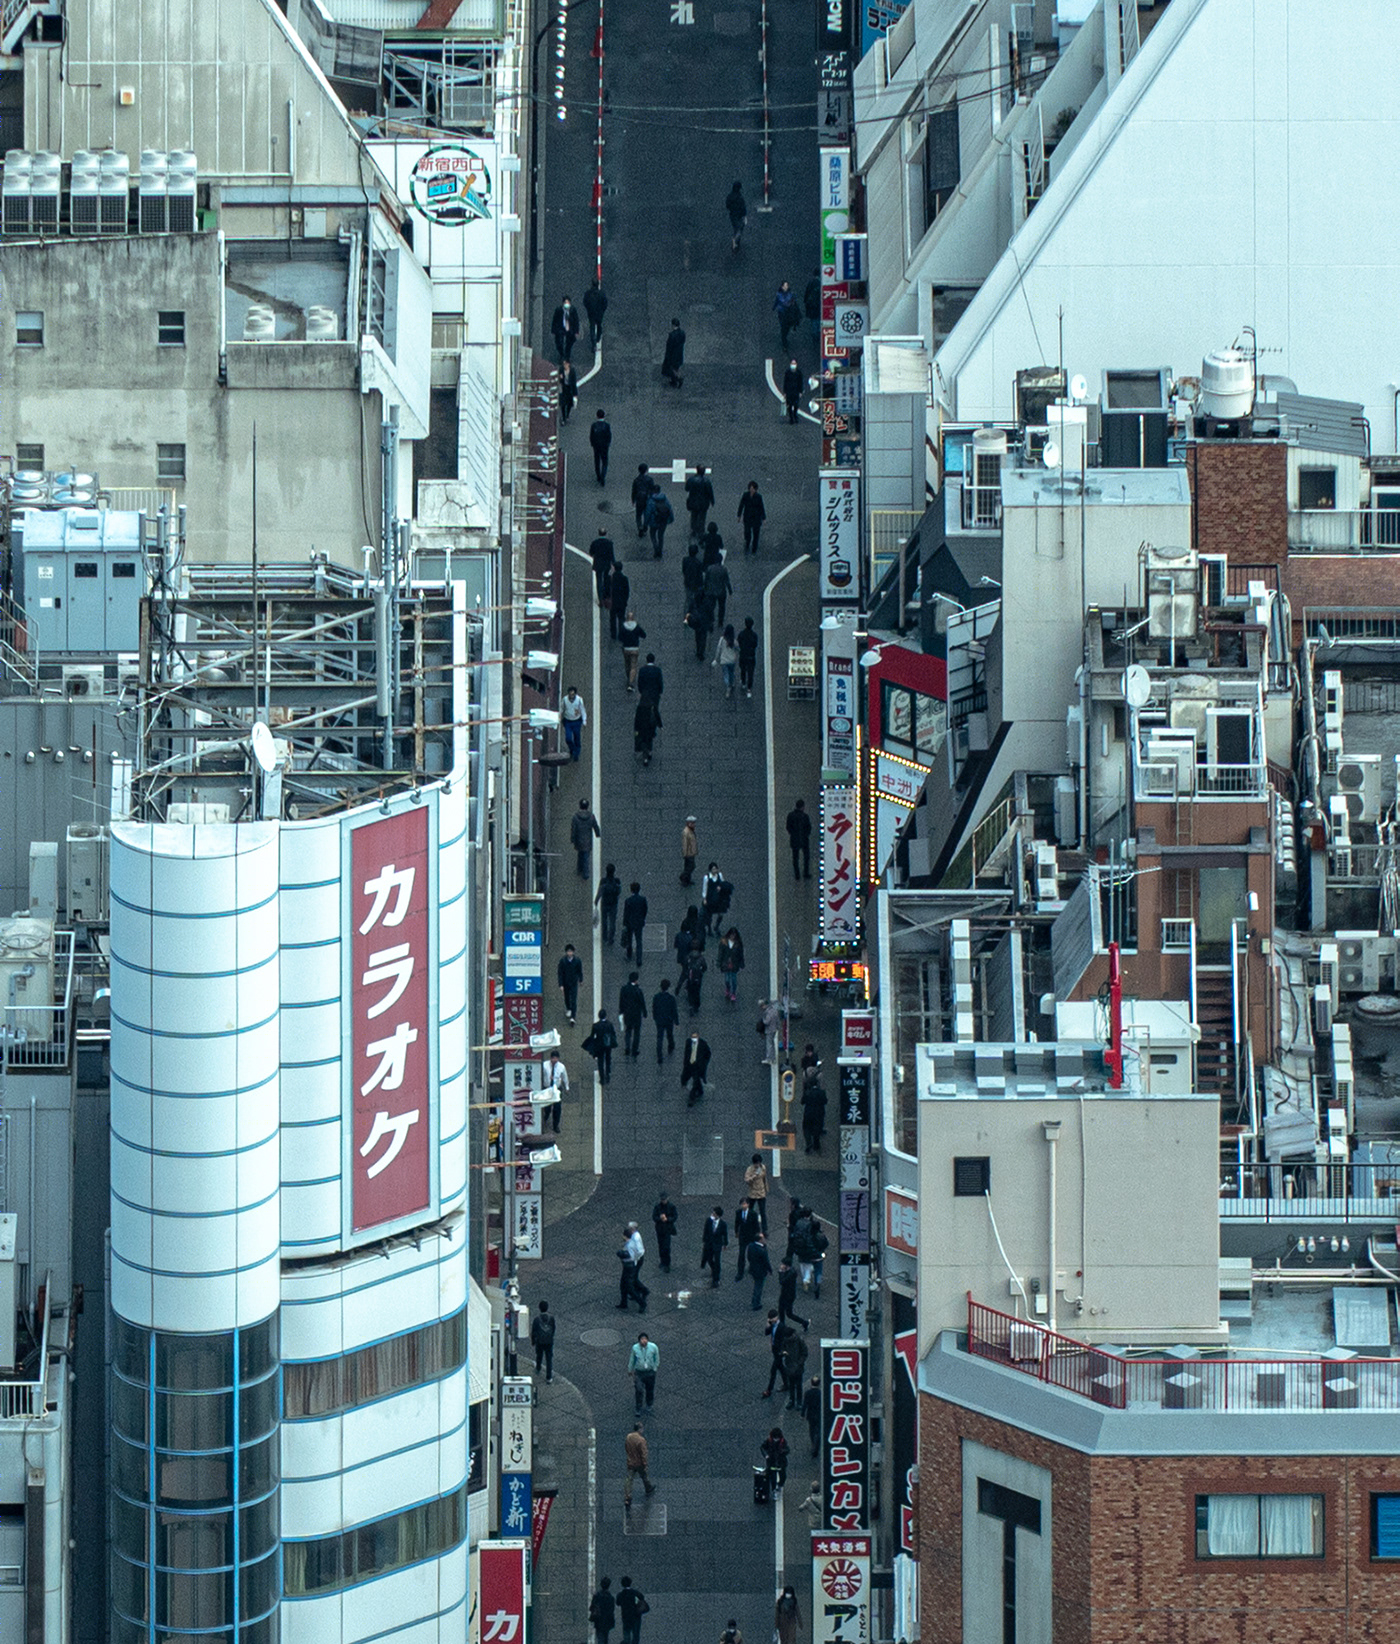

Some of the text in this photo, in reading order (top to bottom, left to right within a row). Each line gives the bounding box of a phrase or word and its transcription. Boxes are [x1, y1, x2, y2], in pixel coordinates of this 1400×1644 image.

[418, 157, 484, 171] 新宿西口
[823, 291, 847, 299] アコム
[826, 496, 842, 558] シムックス
[827, 812, 853, 912] ラーメン
[512, 931, 535, 942] CBR
[515, 979, 532, 991] 5F
[358, 863, 420, 1180] カラオケ
[847, 1088, 862, 1124] 吉永
[847, 1254, 861, 1264] 2F
[509, 1430, 524, 1464] ねぎし
[828, 1349, 863, 1530] ヨドバシカメ
[505, 1477, 528, 1532] かど新
